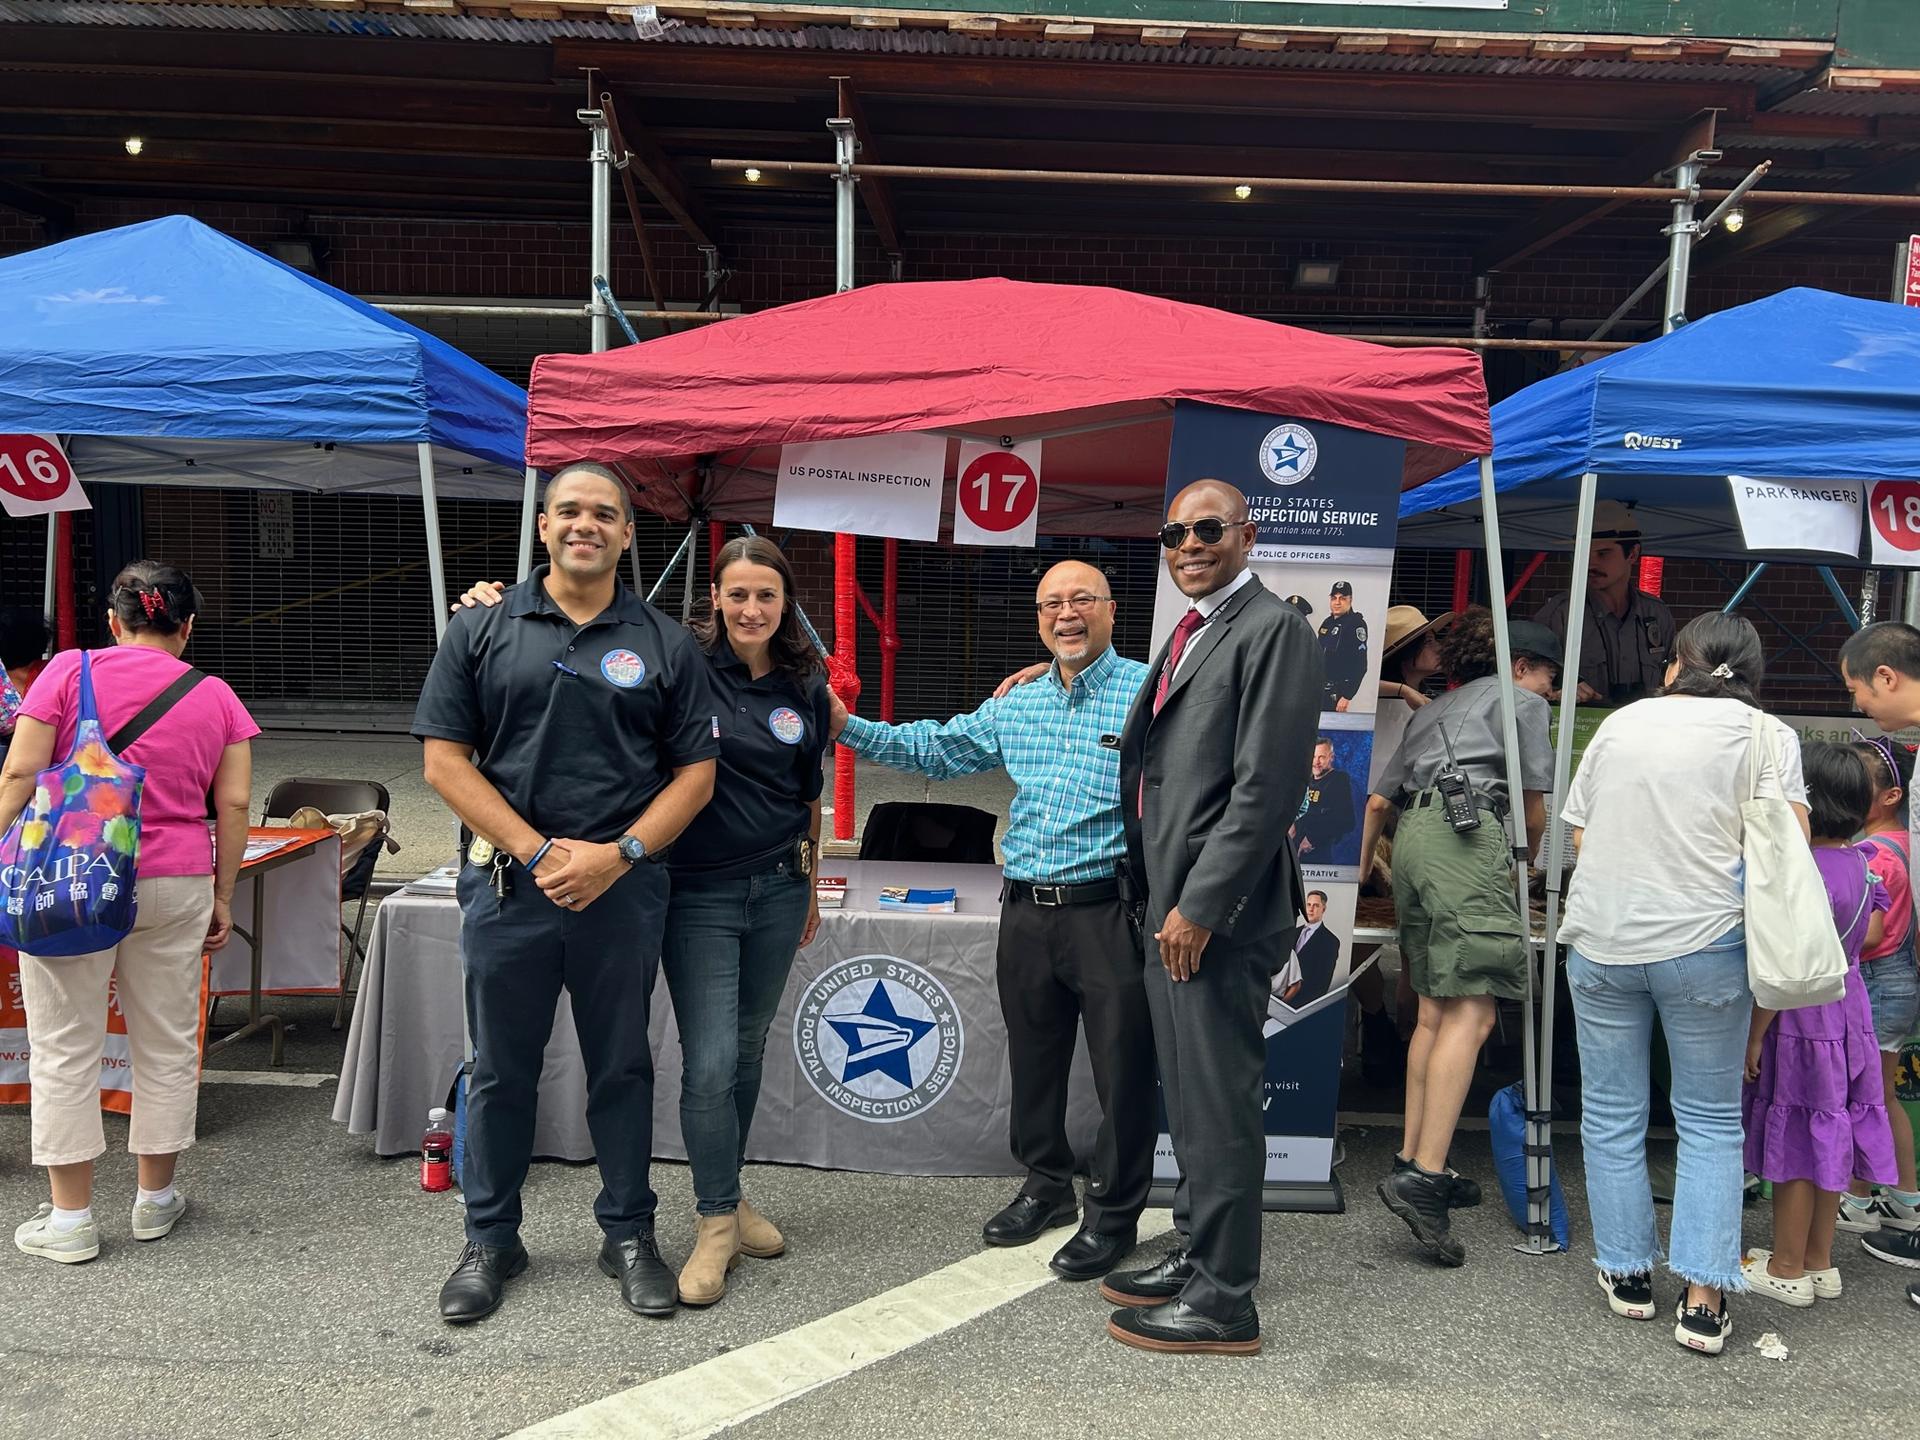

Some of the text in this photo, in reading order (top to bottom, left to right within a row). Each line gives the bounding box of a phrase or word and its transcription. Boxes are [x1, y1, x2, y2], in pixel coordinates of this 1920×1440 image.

[1624, 432, 1682, 450] QUEST
[0, 448, 59, 486] 16
[789, 466, 931, 488] US POSTAL INSPECTION
[971, 472, 1027, 512] 17
[1745, 486, 1857, 504] PARK RANGERS
[1288, 497, 1334, 509] STATES
[1322, 512, 1379, 526] SERVICE
[1880, 494, 1920, 536] 18
[1272, 525, 1298, 535] nation
[1301, 526, 1321, 536] since
[1323, 527, 1345, 537] 1775.
[1290, 552, 1331, 560] OFFICERS
[1, 852, 120, 891] CAIPA
[814, 963, 943, 1008] UNITED STATES
[802, 1017, 957, 1115] POSTAL INSPECTION SERVICE
[1275, 1081, 1300, 1090] visit
